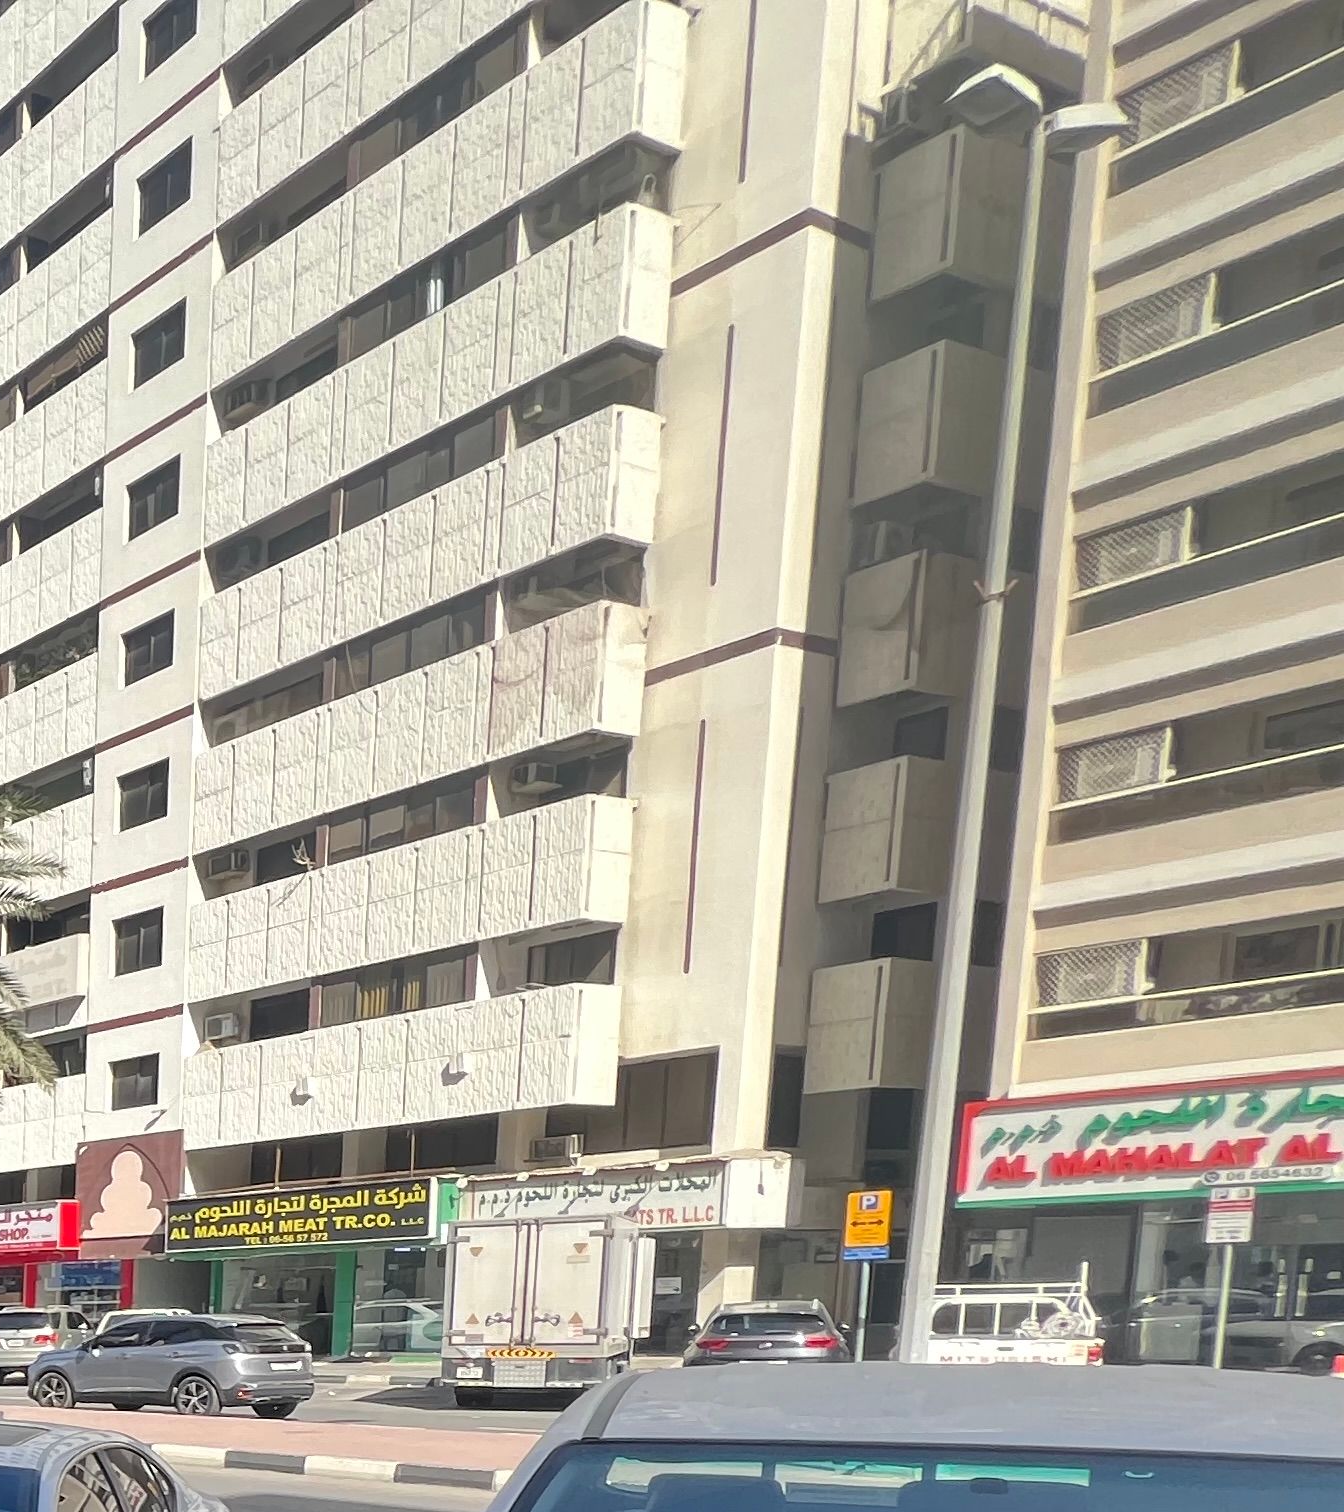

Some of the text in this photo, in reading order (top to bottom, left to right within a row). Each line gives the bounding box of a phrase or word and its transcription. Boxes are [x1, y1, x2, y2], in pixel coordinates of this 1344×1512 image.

[985, 1133, 1343, 1184] AL MAHALAT AL
[308, 1189, 370, 1214] المجرة
[374, 1183, 427, 1209] شركة
[514, 1183, 558, 1214] اللحوم
[562, 1178, 605, 1203] لتجارة
[14, 1207, 53, 1226] متجر
[194, 1200, 251, 1223] اللحوم
[254, 1195, 306, 1219] لتجارة
[169, 1227, 190, 1240] AL
[194, 1221, 274, 1238] MAJARAH
[278, 1217, 328, 1233] MEAT
[332, 1213, 396, 1230] TR.CO.
[244, 1236, 262, 1245] TEL
